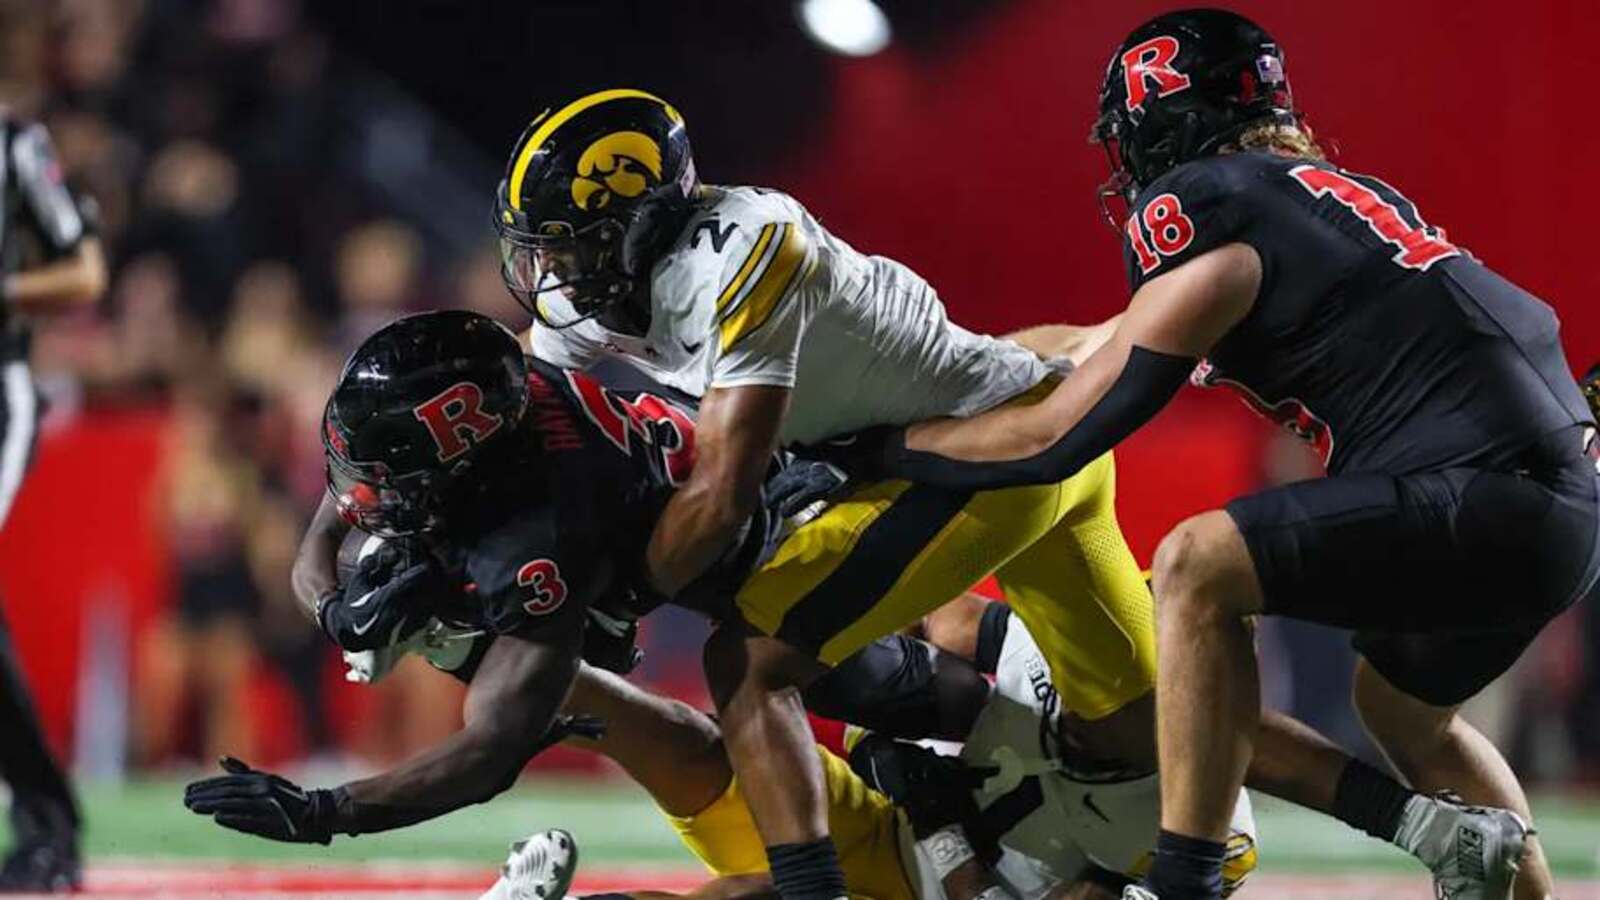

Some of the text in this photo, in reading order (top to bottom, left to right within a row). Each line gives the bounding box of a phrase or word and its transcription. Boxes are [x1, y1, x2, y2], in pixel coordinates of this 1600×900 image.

[1121, 36, 1190, 113] R
[1127, 193, 1194, 275] 18
[415, 382, 501, 463] R
[517, 558, 568, 615] 3
